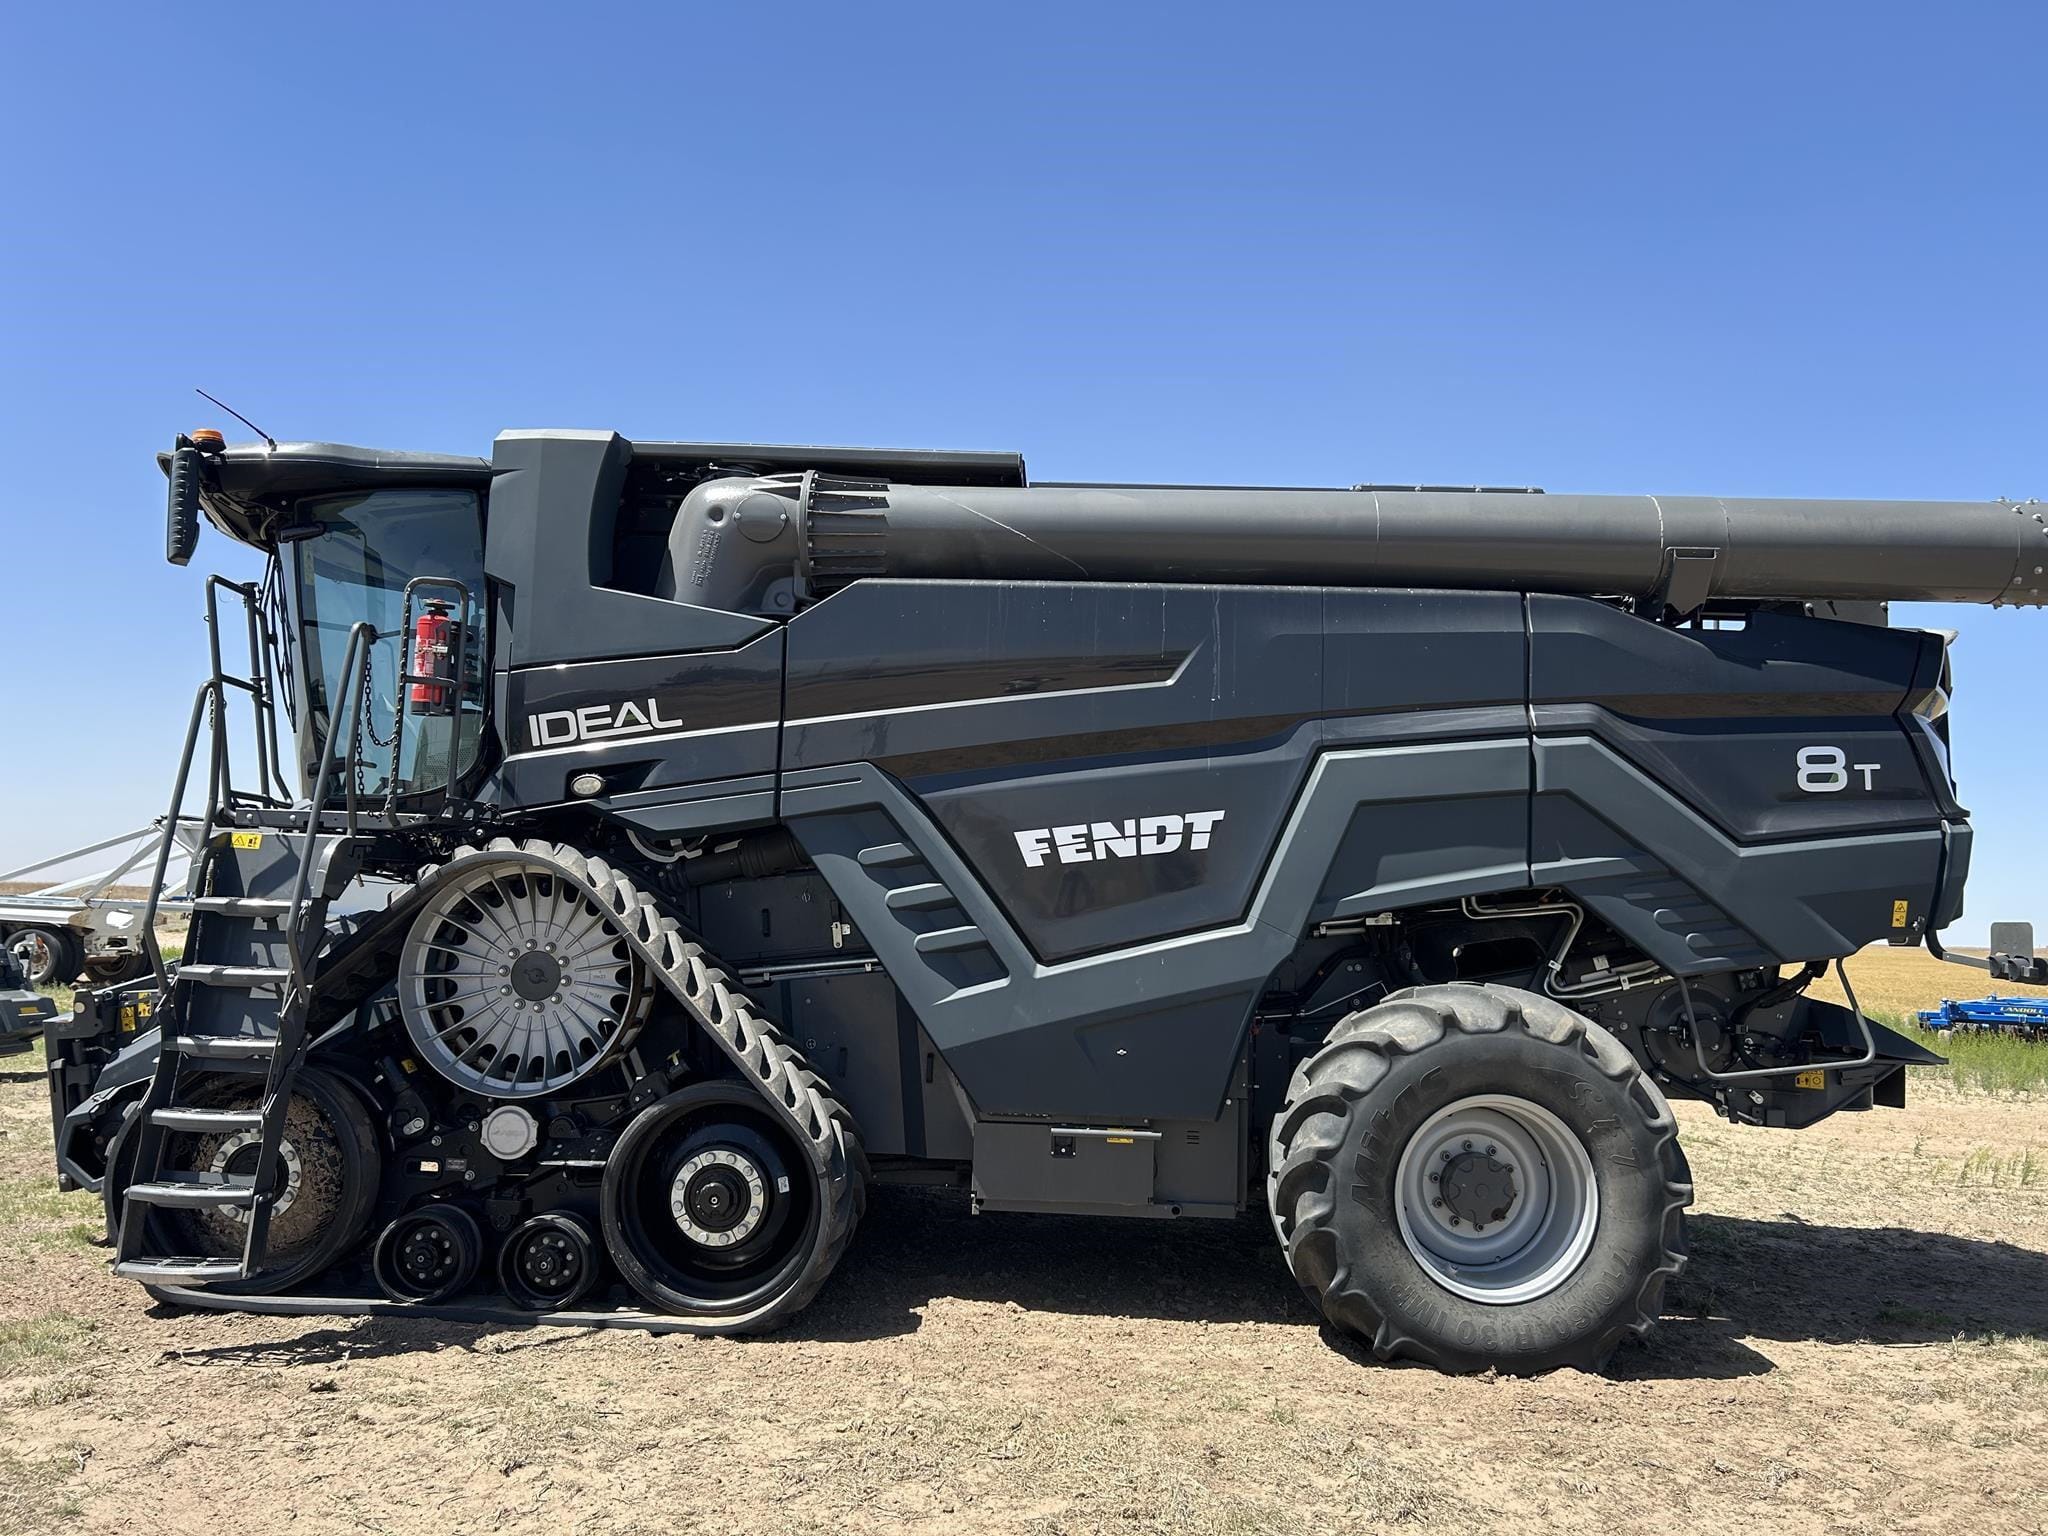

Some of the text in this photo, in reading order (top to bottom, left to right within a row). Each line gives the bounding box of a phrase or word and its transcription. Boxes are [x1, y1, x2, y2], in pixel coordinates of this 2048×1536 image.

[528, 697, 683, 747] IDEAL
[1013, 809, 1226, 868] FENDT
[1351, 1065, 1449, 1222] Mitas
